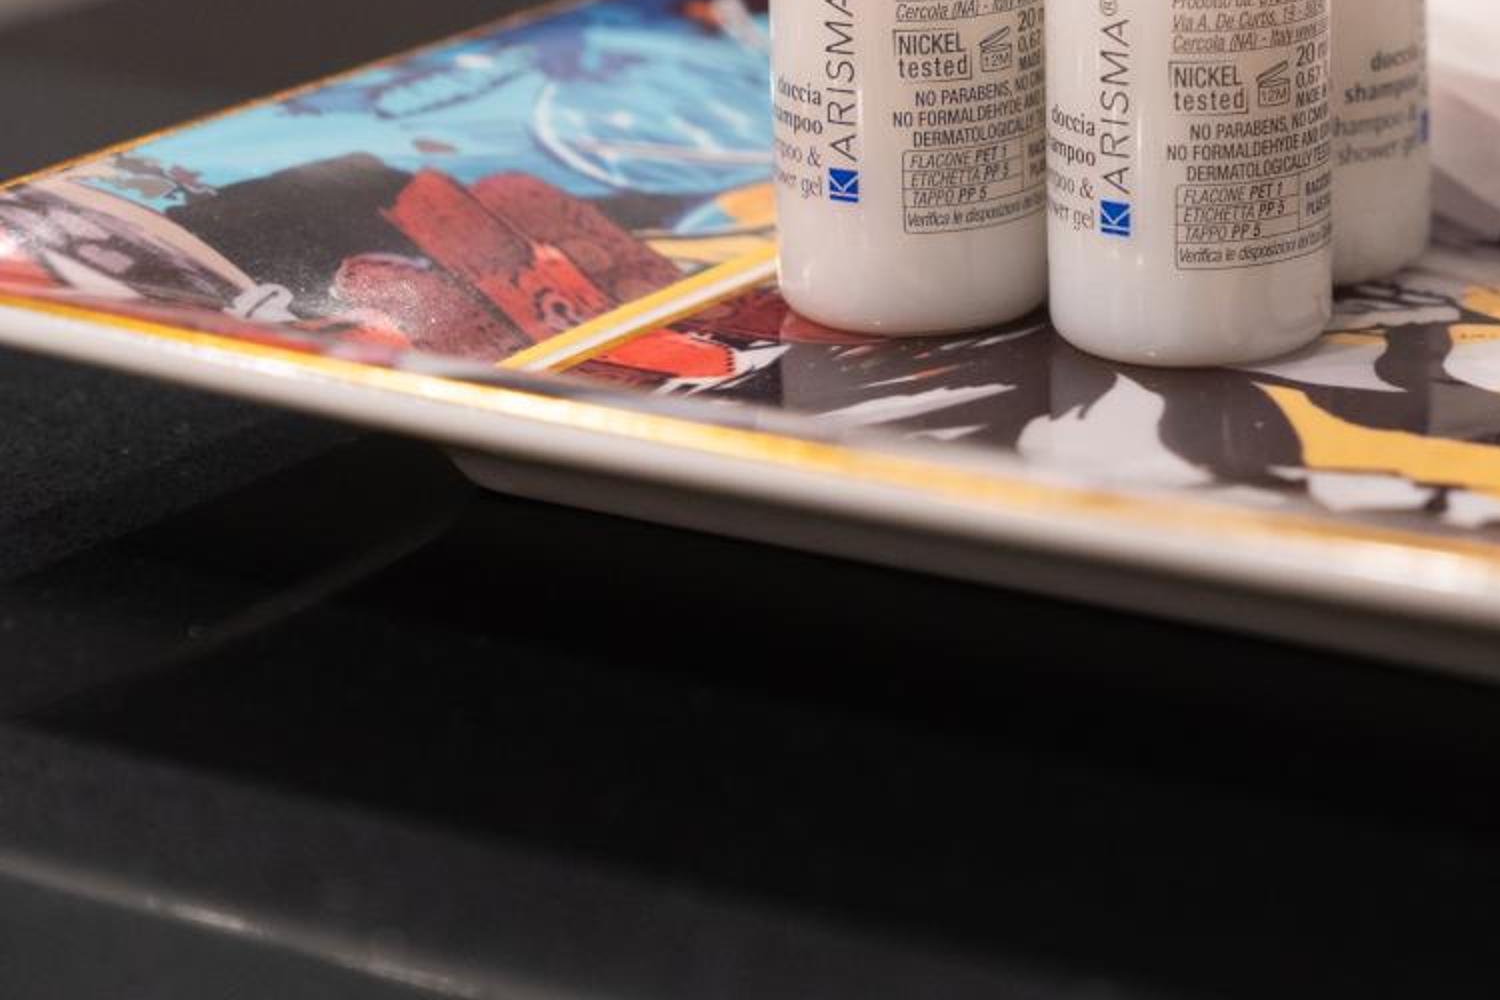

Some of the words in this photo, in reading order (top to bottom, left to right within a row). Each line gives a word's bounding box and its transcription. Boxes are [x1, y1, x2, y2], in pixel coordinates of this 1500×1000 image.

[895, 3, 948, 20] Cercola
[1016, 8, 1036, 32] 20
[1172, 14, 1193, 31] Via
[1216, 12, 1235, 29] De
[897, 32, 966, 56] NICKEL
[1172, 34, 1225, 51] Cercola
[1296, 42, 1315, 67] 20
[898, 54, 967, 79] tested
[1174, 65, 1243, 89] NICKEL
[915, 91, 936, 107] NO
[1174, 88, 1245, 112] tested
[1261, 89, 1287, 102] 12M
[893, 111, 913, 128] NO
[918, 97, 1023, 127] FORMALDEHYDE
[1190, 124, 1211, 141] NO
[1167, 145, 1187, 161] NO
[1193, 134, 1299, 161] FORMALDEHYDE
[910, 152, 972, 169] FLACONE
[1186, 151, 1311, 182] DERMATOLOGICALLY
[911, 169, 981, 188] ETICHETTA
[912, 189, 955, 206] TAPPO
[958, 187, 977, 204] PP
[1184, 187, 1245, 204] FLACONE
[1249, 183, 1274, 200] PET
[1184, 205, 1255, 223] ETICHETTA
[1258, 202, 1275, 217] PP
[1185, 226, 1227, 242] TAPPO
[1231, 223, 1250, 239] PP
[1179, 248, 1222, 264] Verifica
